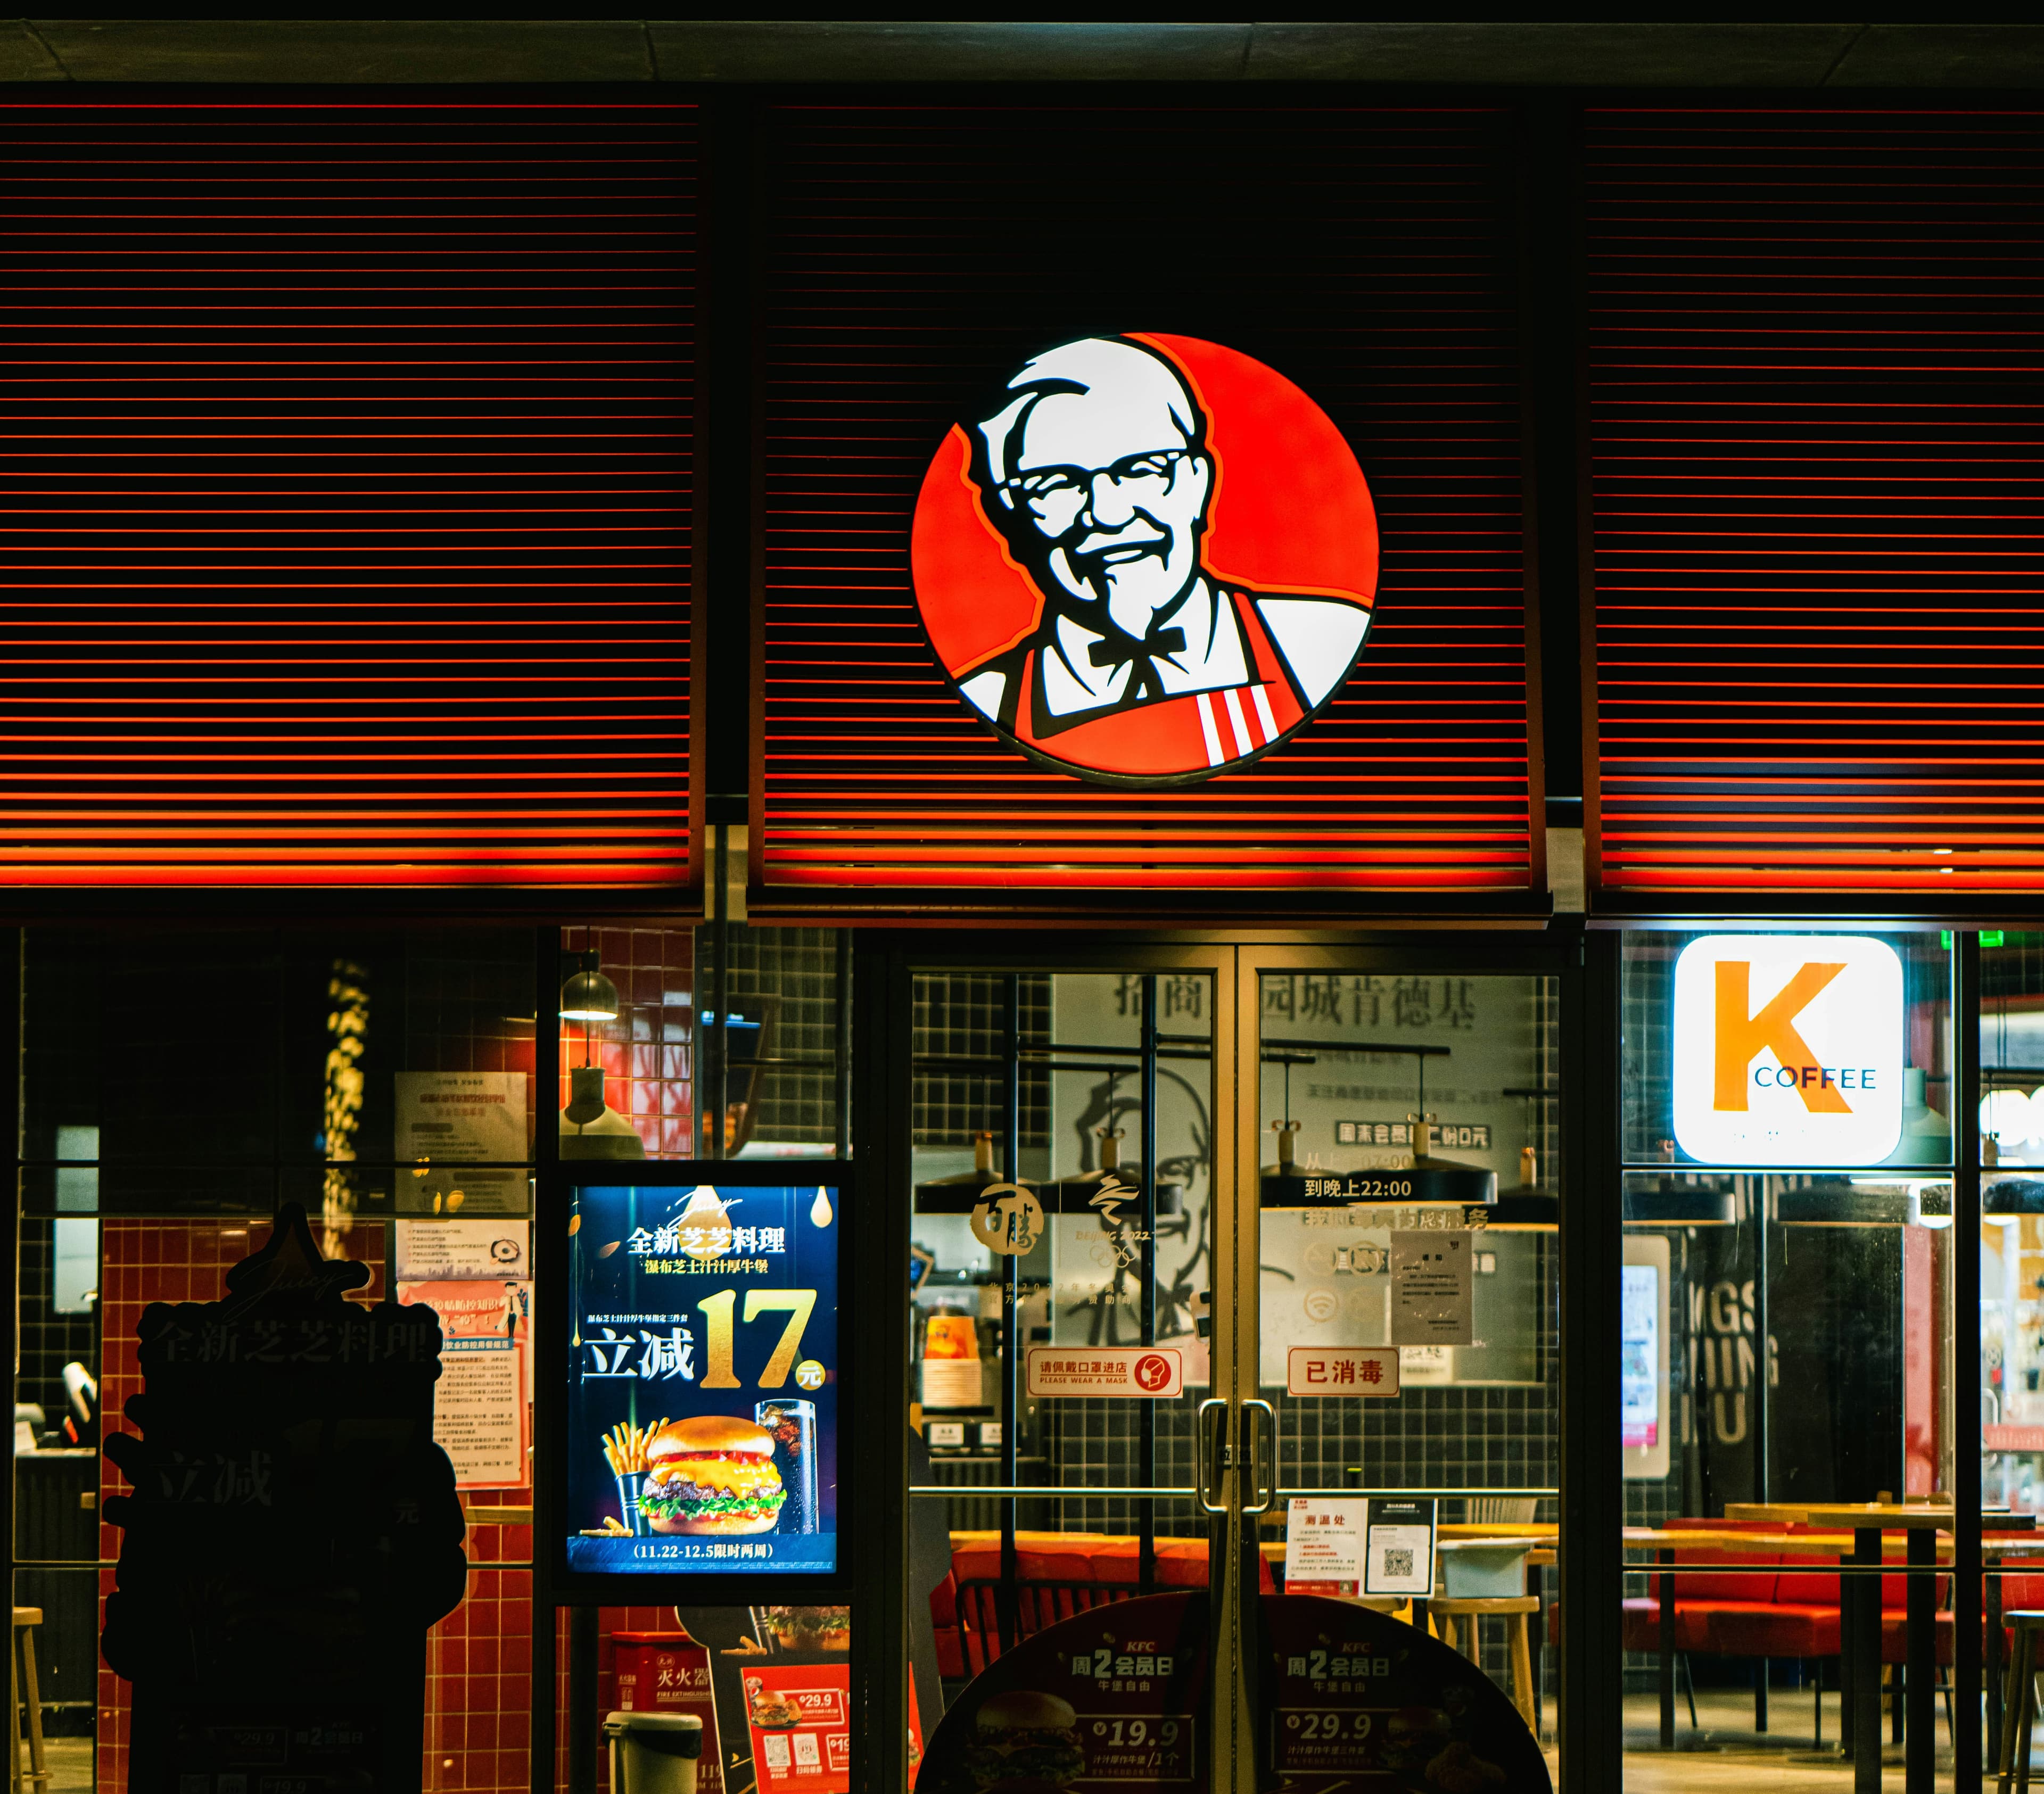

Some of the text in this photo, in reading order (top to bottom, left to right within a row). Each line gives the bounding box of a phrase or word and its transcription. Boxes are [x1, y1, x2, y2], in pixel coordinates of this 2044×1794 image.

[1713, 961, 1853, 1113] K
[1755, 1066, 1876, 1089] COFFEE
[1305, 1179, 1412, 1197] 到晚上22:00
[627, 1226, 786, 1254] 全新芝芝料理
[582, 1289, 822, 1388] 立减 17 元
[1040, 1360, 1127, 1374] 请佩戴口罩进店
[1307, 1359, 1384, 1385] 已消毒
[1305, 1515, 1345, 1526] 测温处
[1126, 1642, 1155, 1652] KFC
[1341, 1642, 1371, 1652] KFC
[1072, 1649, 1174, 1679] 周2会员日
[1287, 1650, 1390, 1680] 周2会员日
[657, 1668, 710, 1687] 灭火器
[1098, 1680, 1150, 1692] 牛堡自由
[1313, 1681, 1366, 1693] 牛堡自由
